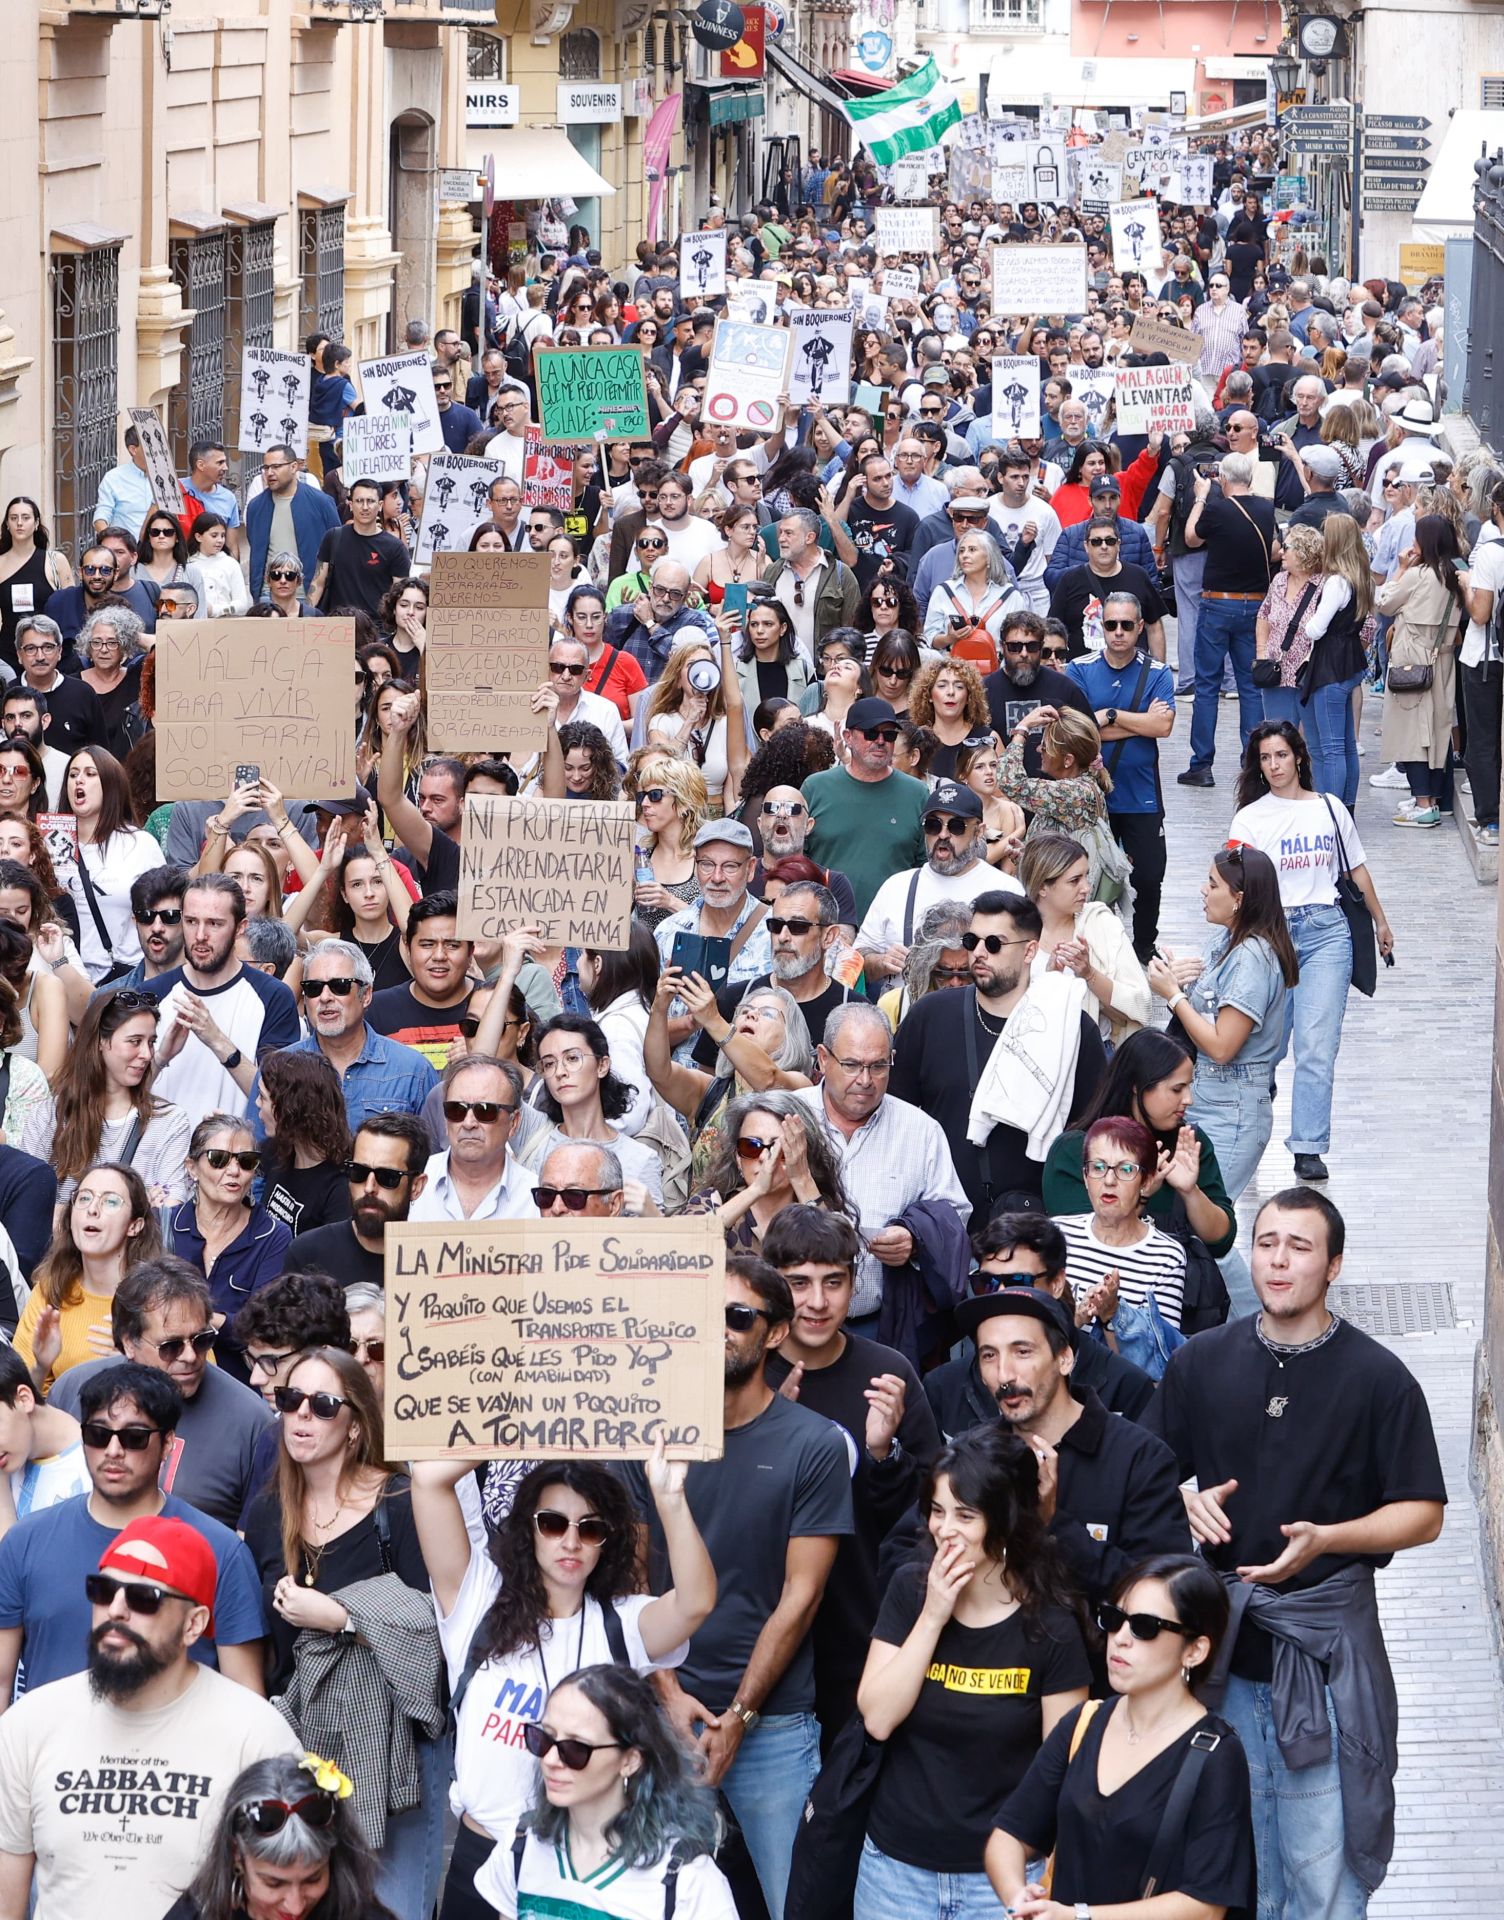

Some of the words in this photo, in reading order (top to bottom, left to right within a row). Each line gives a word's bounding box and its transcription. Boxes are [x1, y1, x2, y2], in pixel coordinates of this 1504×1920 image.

[695, 19, 738, 41] GUINNESS
[571, 93, 617, 108] SOUVENIRS
[692, 232, 725, 243] BOQUERONES
[793, 315, 803, 325] SIN
[805, 312, 852, 327] BOQUERONES
[248, 350, 259, 358] SIN
[260, 349, 306, 367] BOQUERONES
[363, 367, 377, 379] SIN
[377, 353, 428, 378] BOQUERONES
[1003, 358, 1038, 369] BOQUERONES
[539, 357, 558, 384] LA
[561, 354, 607, 382] ÚNICA
[607, 354, 642, 381] CASA
[1069, 370, 1079, 378] SIN
[1079, 368, 1115, 380] BOQUERON
[540, 382, 561, 405] QUE
[561, 381, 574, 401] ME
[577, 380, 603, 402] PUEDO
[604, 380, 643, 402] PERMITIR
[1122, 383, 1193, 406] LEVANTAOS
[1151, 404, 1187, 416] HOGAR
[624, 415, 644, 427] PACO
[1146, 418, 1193, 432] LIBERTAD
[346, 437, 358, 454] NI
[363, 434, 397, 451] TORRES
[525, 441, 577, 461] TERRITORIOS
[346, 459, 358, 477] NI
[432, 456, 445, 467] SIN
[446, 455, 499, 473] BOQUERONES
[435, 556, 457, 570] NO
[463, 557, 538, 571] QUEREMOS
[435, 571, 485, 581] IRNOS
[491, 570, 513, 582] AL
[435, 580, 523, 591] EXTRARRADIO.
[432, 591, 501, 606] QUEREMOS
[431, 608, 512, 624] QUEDARNOS
[519, 609, 541, 622] EN
[431, 623, 464, 645] EL
[166, 632, 325, 685] MÁLAGA
[430, 653, 541, 671] VIVIENDA
[430, 670, 541, 688] ESPECULADA
[163, 690, 224, 718] PARA
[430, 693, 534, 707] DESOBEDIENCI
[430, 709, 482, 721] CIVIL
[165, 726, 208, 753] NO
[235, 723, 321, 752] PARA
[40, 823, 77, 831] COMBATE
[469, 799, 494, 840] NI
[507, 800, 632, 853] PROPIETARIA
[1280, 833, 1334, 856] MÁLAG
[462, 846, 483, 881] NI
[1280, 854, 1311, 872] PARA
[471, 884, 577, 913] ESTANCADA
[581, 889, 608, 915] EN
[536, 919, 561, 940] DE
[568, 915, 625, 946] MAMÁ
[396, 1243, 429, 1276] LA
[436, 1241, 543, 1274] MINISTRA
[552, 1239, 592, 1272] PIDE
[599, 1236, 714, 1273] SOLIDARIDAD
[394, 1292, 411, 1323] Y
[419, 1292, 486, 1320] PAQUITO
[492, 1295, 529, 1315] QUE
[533, 1290, 593, 1315] USEMOS
[602, 1297, 629, 1313] EL
[511, 1318, 618, 1340] TRANSPORTE
[621, 1316, 697, 1340] PÚBLICO
[491, 1346, 527, 1368] QUÉ
[529, 1348, 562, 1366] LES
[572, 1344, 617, 1367] PIDO
[469, 1367, 504, 1385] (CON
[394, 1393, 442, 1421] QUE
[447, 1395, 471, 1413] SE
[476, 1392, 533, 1413] VAYAN
[542, 1393, 566, 1413] UN
[447, 1419, 476, 1448] A
[482, 1414, 589, 1450] TOMAR
[593, 1419, 640, 1450] POR
[948, 1667, 967, 1686] NO
[969, 1672, 985, 1689] SE
[989, 1673, 1028, 1689] VENDE
[481, 1712, 527, 1750] PAR
[99, 1755, 139, 1765] Member
[140, 1756, 151, 1766] of
[153, 1757, 169, 1767] the
[54, 1769, 212, 1797] SABBATH
[59, 1792, 200, 1819] CHURCH
[82, 1831, 99, 1843] We
[100, 1831, 125, 1844] Obey
[125, 1832, 143, 1843] The
[144, 1833, 164, 1845] Riff
